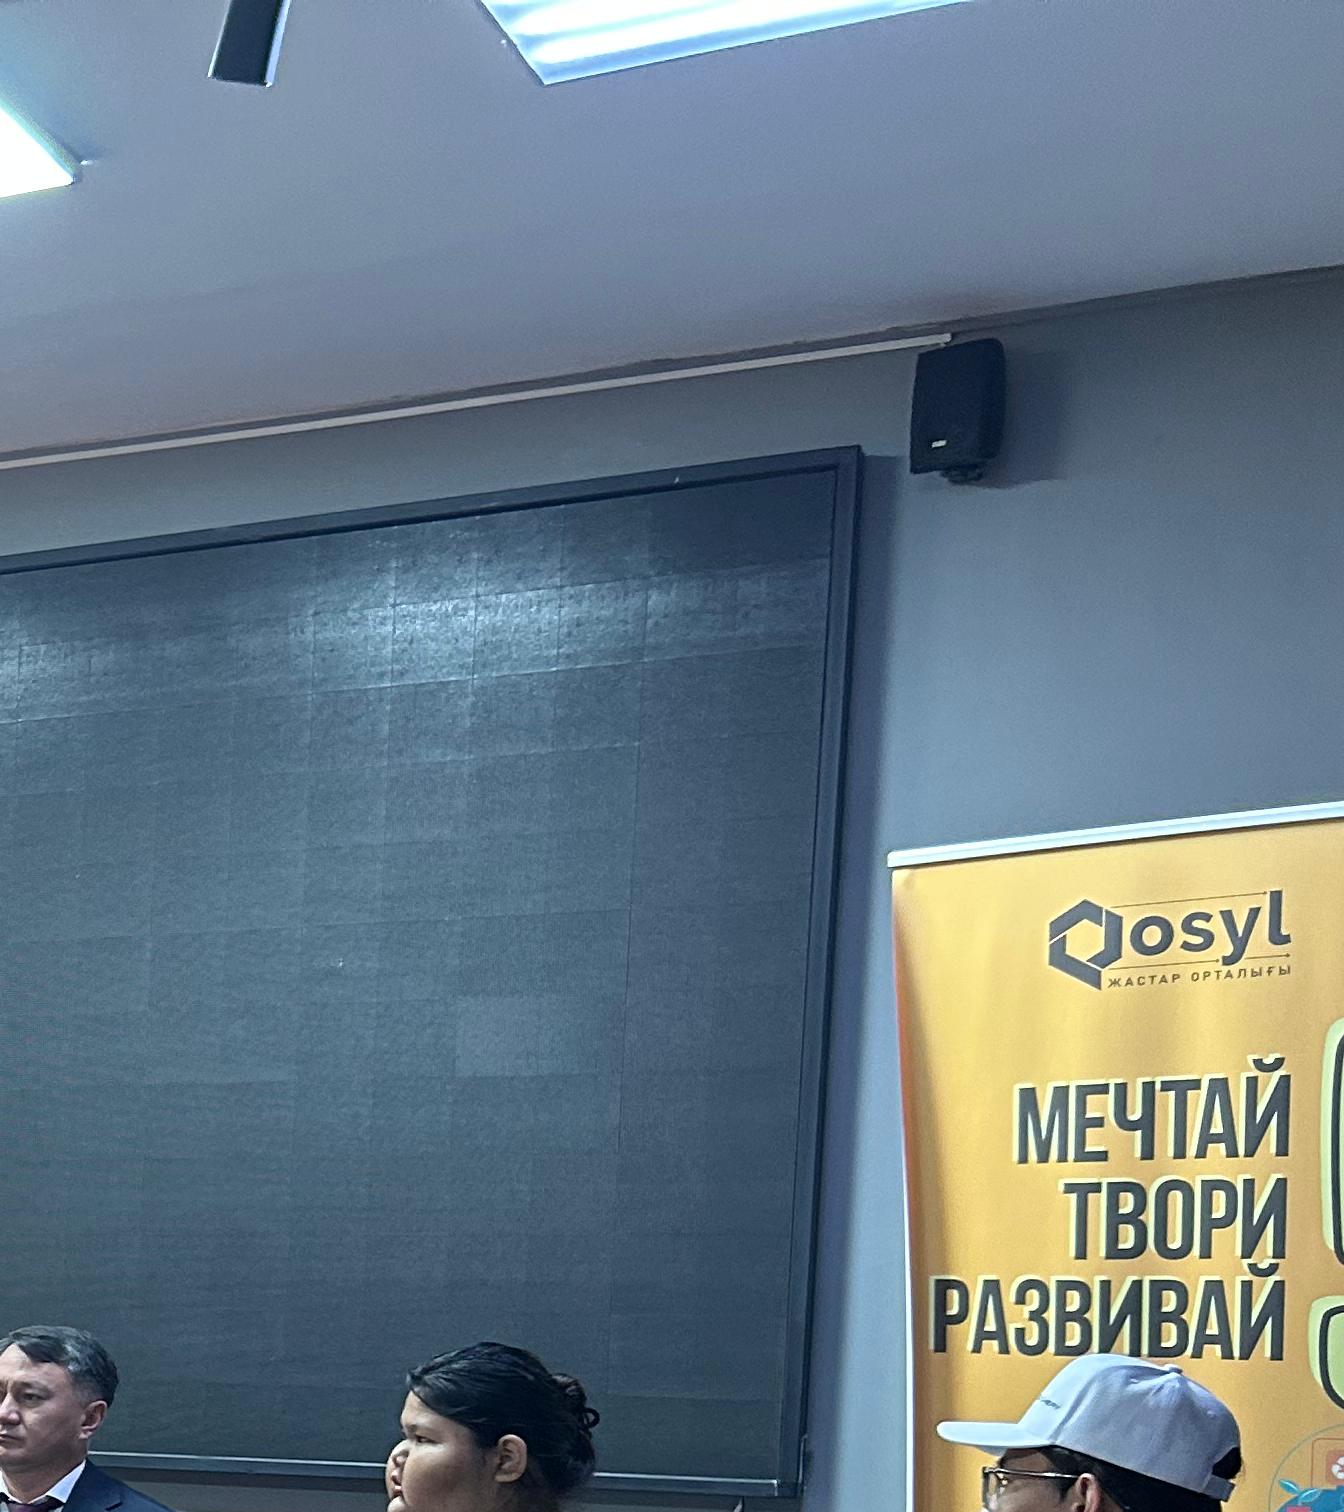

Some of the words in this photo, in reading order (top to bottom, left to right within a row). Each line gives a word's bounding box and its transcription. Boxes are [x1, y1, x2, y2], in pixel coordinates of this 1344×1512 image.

[1107, 973, 1182, 990] ЖАСТАР
[1013, 1054, 1292, 1165] МЕЧТАЙ
[1059, 1174, 1289, 1260] ТВОРИ
[929, 1259, 1287, 1361] РАЗВИВАЙ
